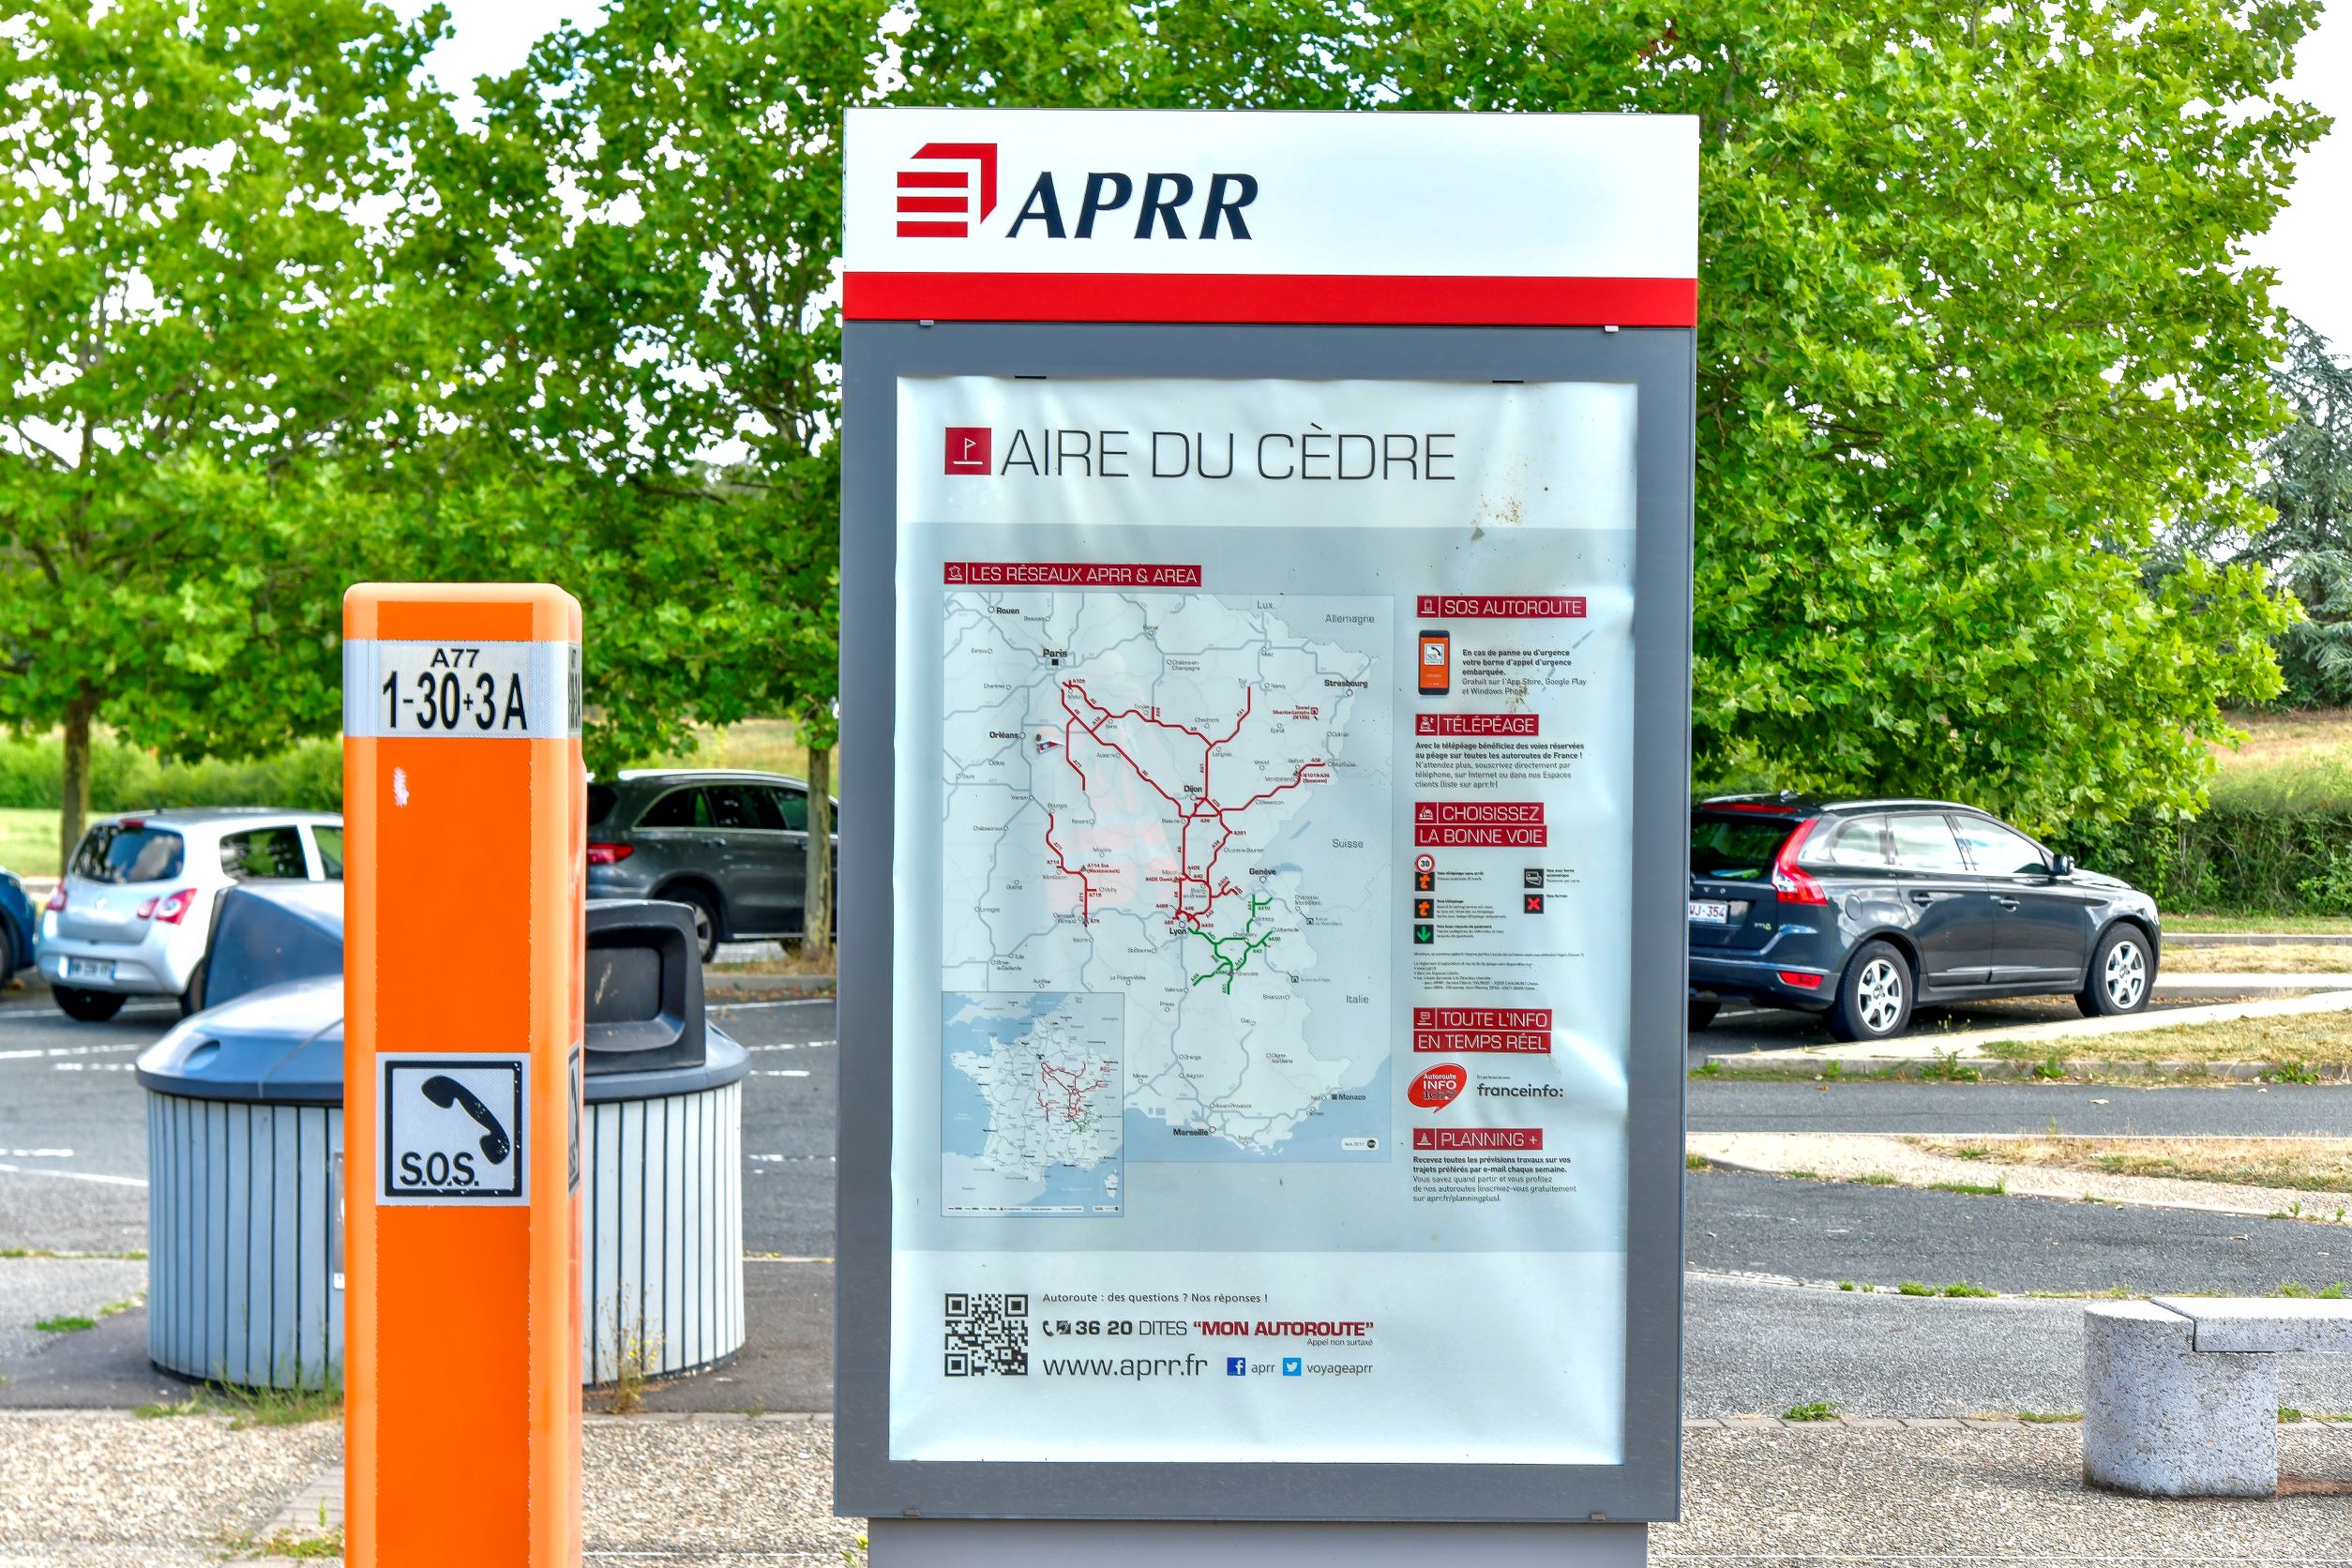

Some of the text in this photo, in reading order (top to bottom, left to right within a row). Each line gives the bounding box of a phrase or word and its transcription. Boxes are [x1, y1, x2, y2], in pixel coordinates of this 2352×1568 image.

[1004, 171, 1259, 240] APRR
[1001, 423, 1455, 480] AIRE DU CÈDRE
[972, 565, 1197, 583] LES RÉSEAUX APRR & AREA
[1257, 601, 1275, 610] Lux.
[1444, 600, 1582, 615] SOS AUTOROUTE
[1325, 614, 1375, 625] Allemagne
[430, 648, 480, 668] A77
[1533, 649, 1570, 657] d'urgence
[1535, 658, 1572, 667] d'urgence
[1324, 680, 1367, 688] Strasbourg
[1443, 716, 1534, 732] TÉLÉPÉAGE
[1426, 752, 1448, 761] péage
[1544, 772, 1571, 780] Espaces
[1184, 785, 1202, 793] Dijon
[1442, 806, 1539, 821] CHOISISSEZ
[1420, 829, 1543, 843] LA BONNE VOIE
[1333, 839, 1364, 848] Suisse
[1249, 867, 1276, 876] Genève
[1346, 995, 1369, 1003] Italie
[1441, 1011, 1547, 1028] TOUTE L'INFO
[1419, 1033, 1546, 1050] EN TEMPS RÉEL
[1424, 1080, 1456, 1090] INFO
[1477, 1083, 1563, 1097] franceinfo:
[1424, 1091, 1455, 1100] 107.7
[1173, 1128, 1208, 1137] Marseille
[1441, 1133, 1524, 1146] PLANNING
[400, 1152, 479, 1186] S.O.S.
[1454, 1176, 1475, 1184] quand
[1478, 1176, 1498, 1184] partir
[1526, 1176, 1552, 1184] profitez
[1530, 1185, 1576, 1194] gratuitement
[1043, 1293, 1097, 1303] Autoroute
[1108, 1293, 1125, 1302] des
[1128, 1294, 1179, 1304] questions
[1191, 1293, 1211, 1303] Nos
[1214, 1294, 1260, 1304] réponses
[1076, 1320, 1100, 1335] 36
[1108, 1320, 1133, 1335] 20
[1139, 1320, 1187, 1335] DITES
[1307, 1338, 1328, 1347] Appel
[1043, 1353, 1208, 1380] www.aprr.fr
[1251, 1364, 1275, 1374] aprr
[1307, 1364, 1373, 1376] voyageaprr
